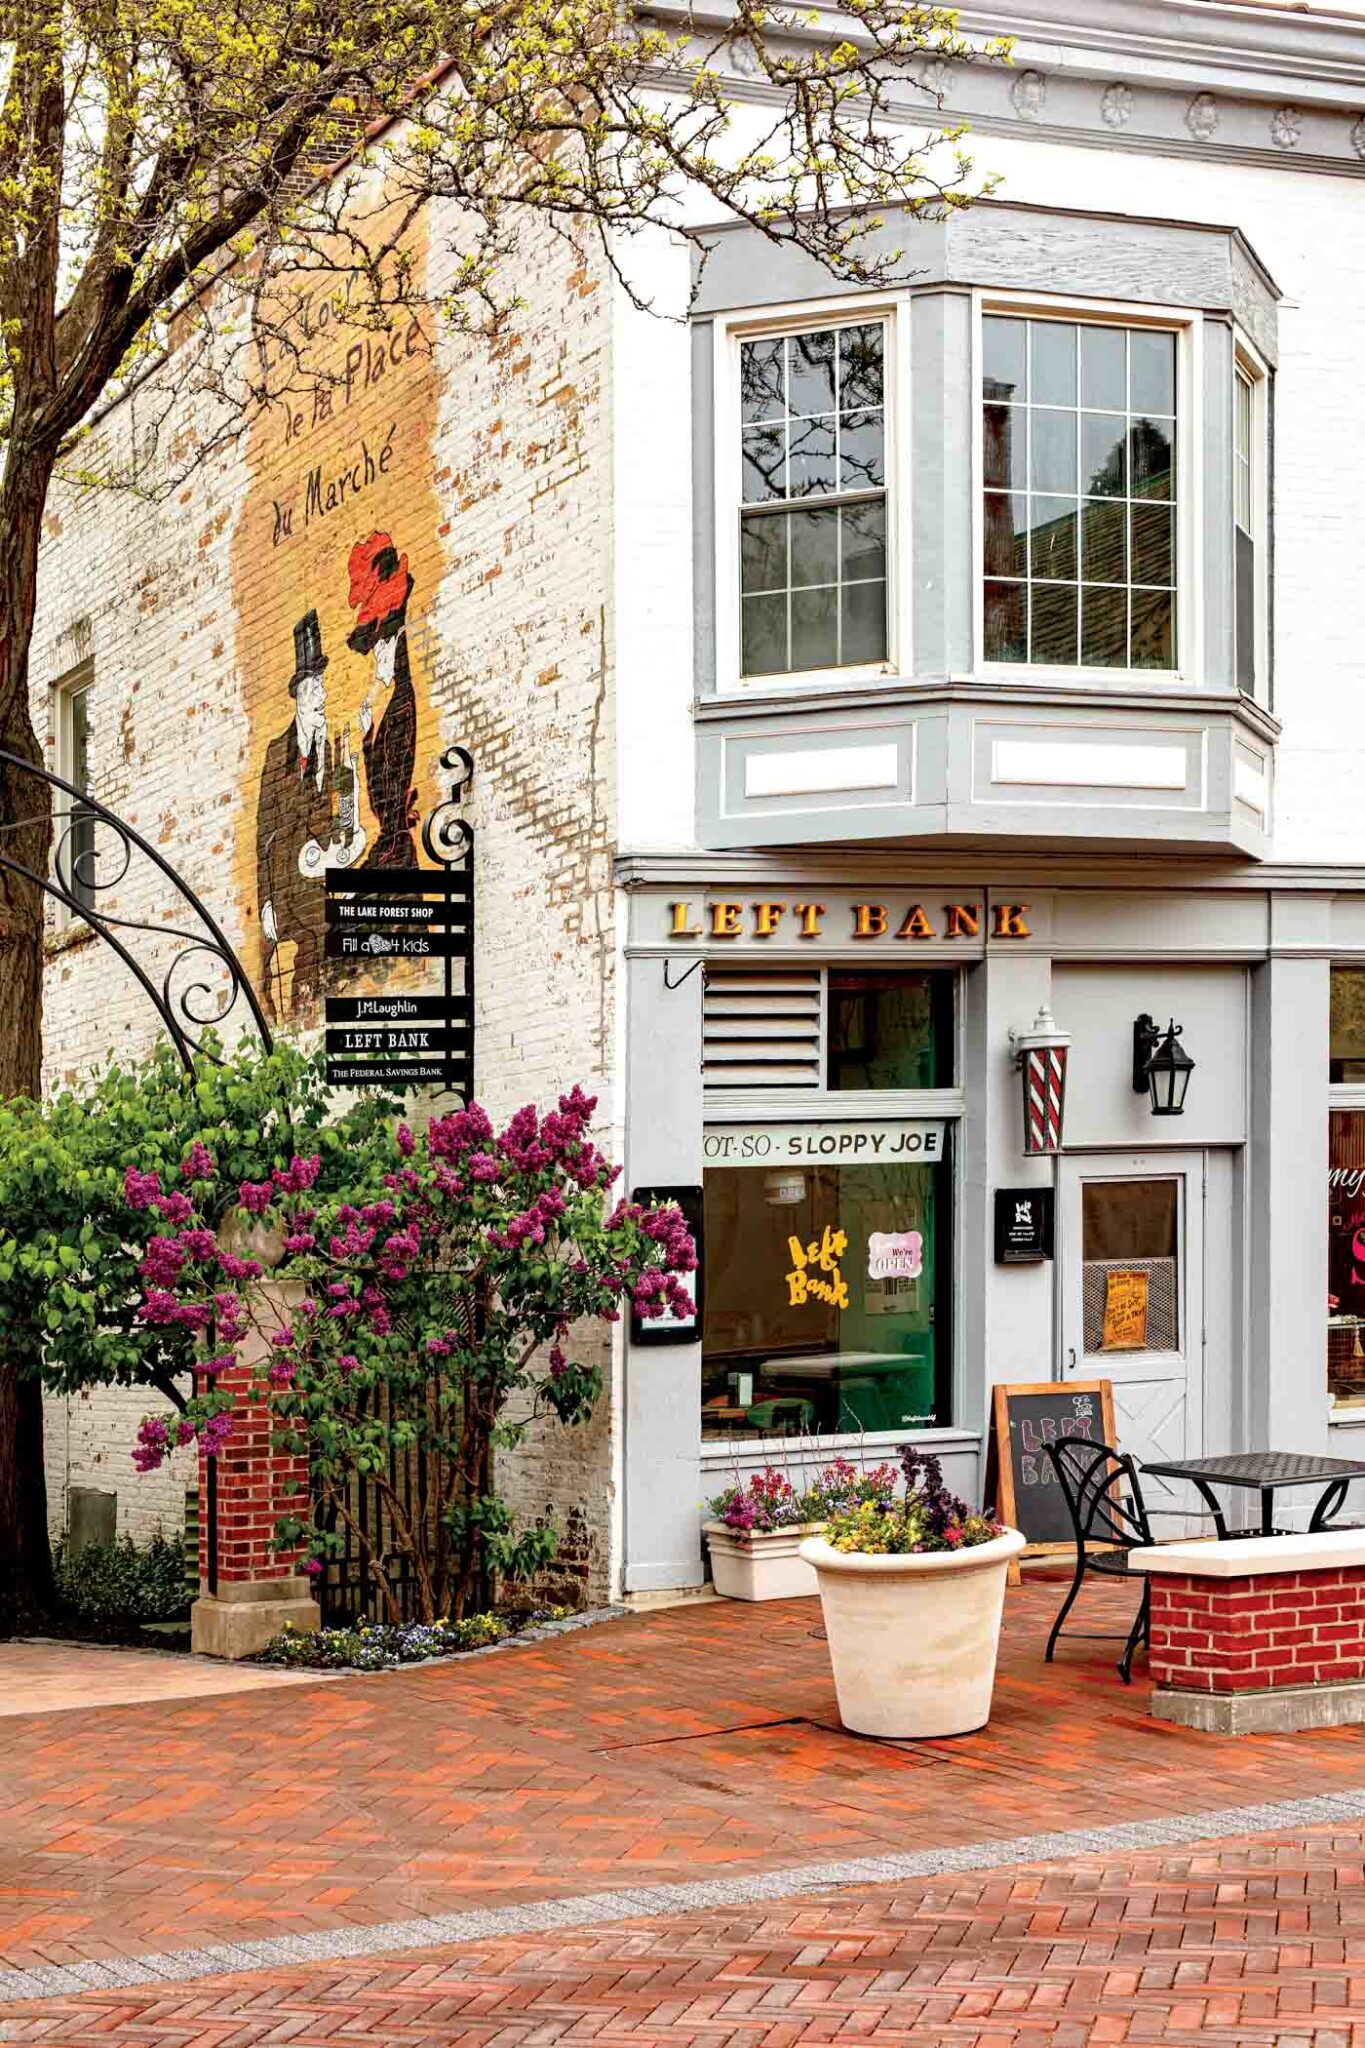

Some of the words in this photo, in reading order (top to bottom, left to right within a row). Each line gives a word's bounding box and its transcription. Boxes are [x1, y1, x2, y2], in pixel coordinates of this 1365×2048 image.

[311, 380, 335, 429] la
[345, 320, 422, 404] Place
[305, 421, 397, 526] Marché
[339, 906, 355, 916] THE
[357, 907, 378, 917] LAKE
[380, 907, 409, 917] FOREST
[411, 908, 434, 918] SHOP
[669, 901, 827, 937] LEFT
[853, 903, 1032, 938] BANK
[342, 938, 358, 952] Fill
[361, 942, 370, 952] a
[391, 938, 400, 952] 4
[402, 937, 430, 953] kids
[356, 1000, 418, 1018] J.McLaughlin
[345, 1033, 382, 1048] LEFT
[388, 1033, 429, 1048] BANK
[332, 1069, 349, 1078] THE
[350, 1068, 385, 1078] FEDERAL
[386, 1067, 418, 1077] SAVINGS
[420, 1066, 442, 1076] BANK
[788, 1133, 886, 1155] SLOPPY
[890, 1132, 937, 1152] JOE
[788, 1225, 848, 1271] Left
[892, 1248, 913, 1256] We're
[876, 1257, 913, 1271] OPEN
[785, 1267, 849, 1309] Bank
[1021, 1416, 1095, 1452] LEFT
